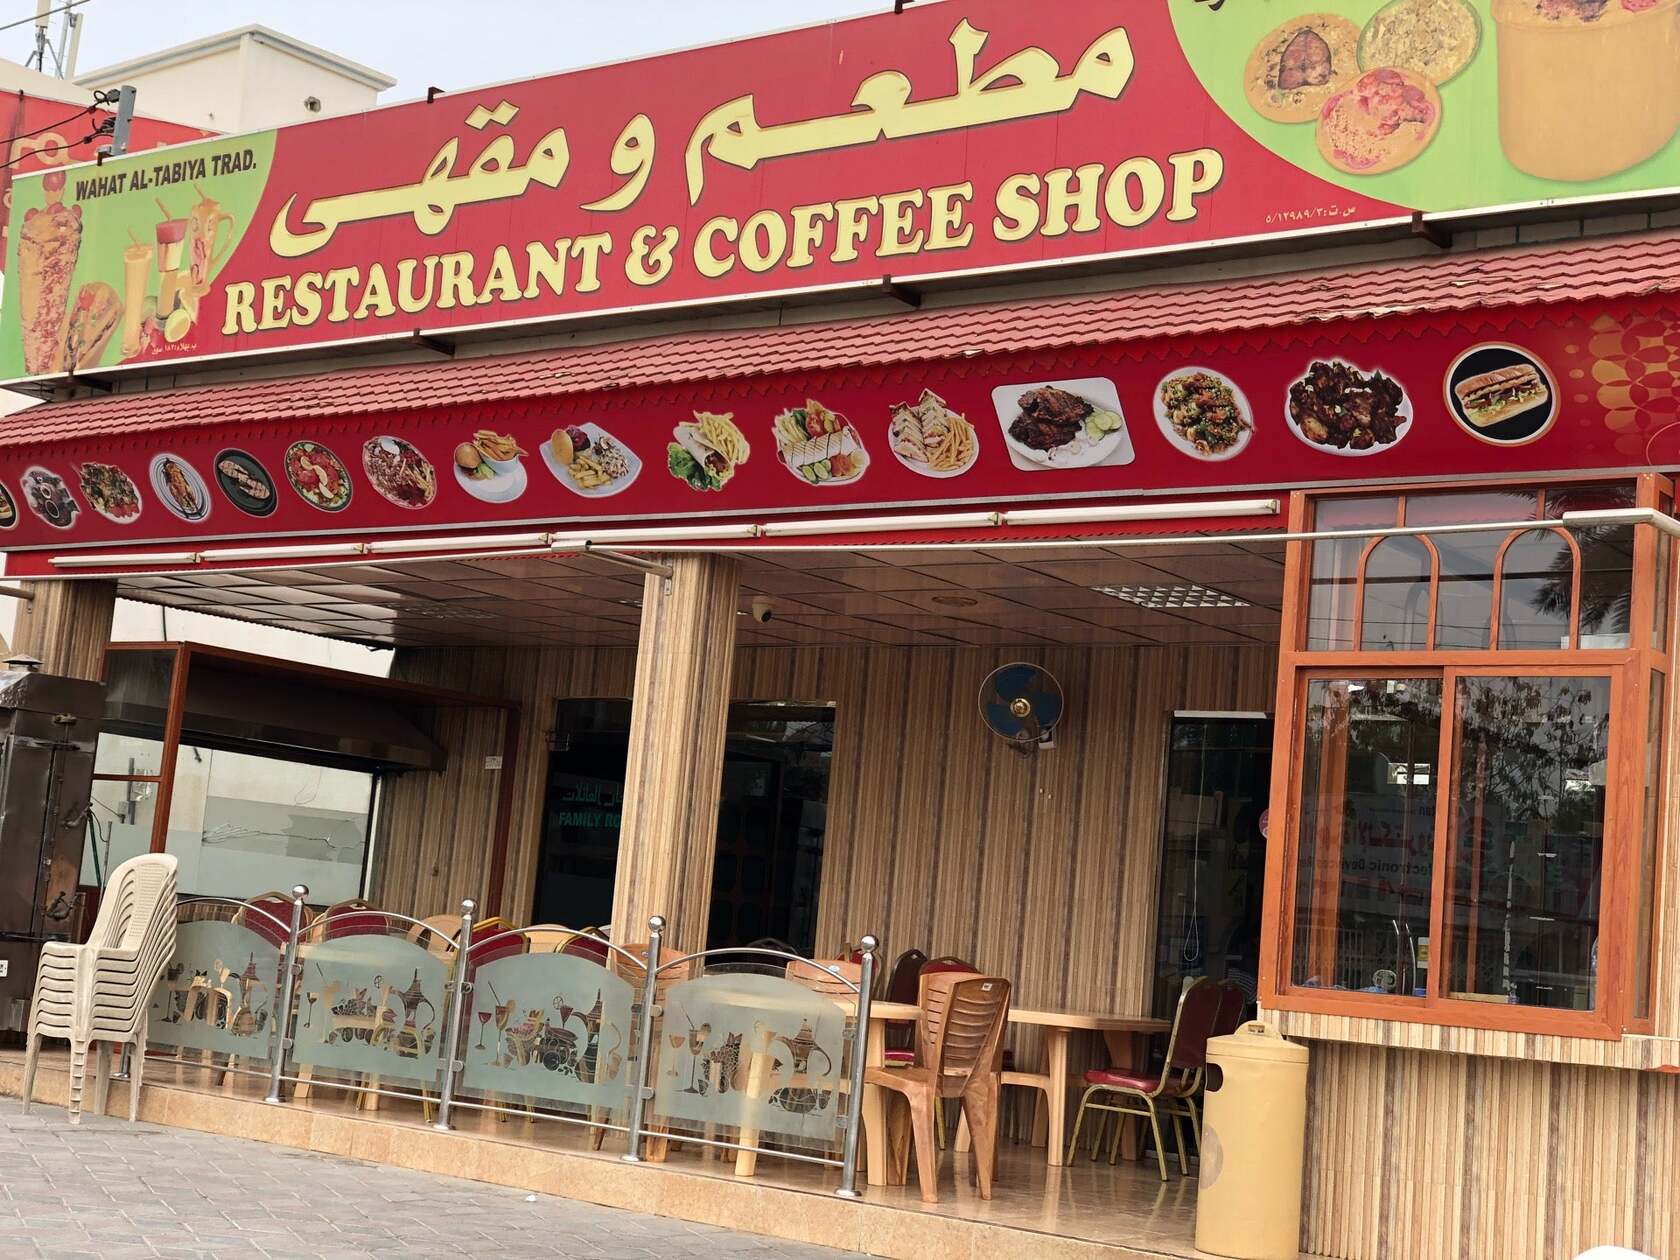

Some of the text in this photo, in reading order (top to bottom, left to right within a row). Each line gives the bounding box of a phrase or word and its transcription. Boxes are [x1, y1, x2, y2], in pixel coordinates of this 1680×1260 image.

[75, 149, 257, 201] WAHAT AL-TABIYA TRAD.
[269, 17, 1135, 258] مطعم و مقهى
[221, 147, 1224, 335] RESTAURANT & COFFEE SHOP
[559, 811, 621, 830] FAMILY RO
